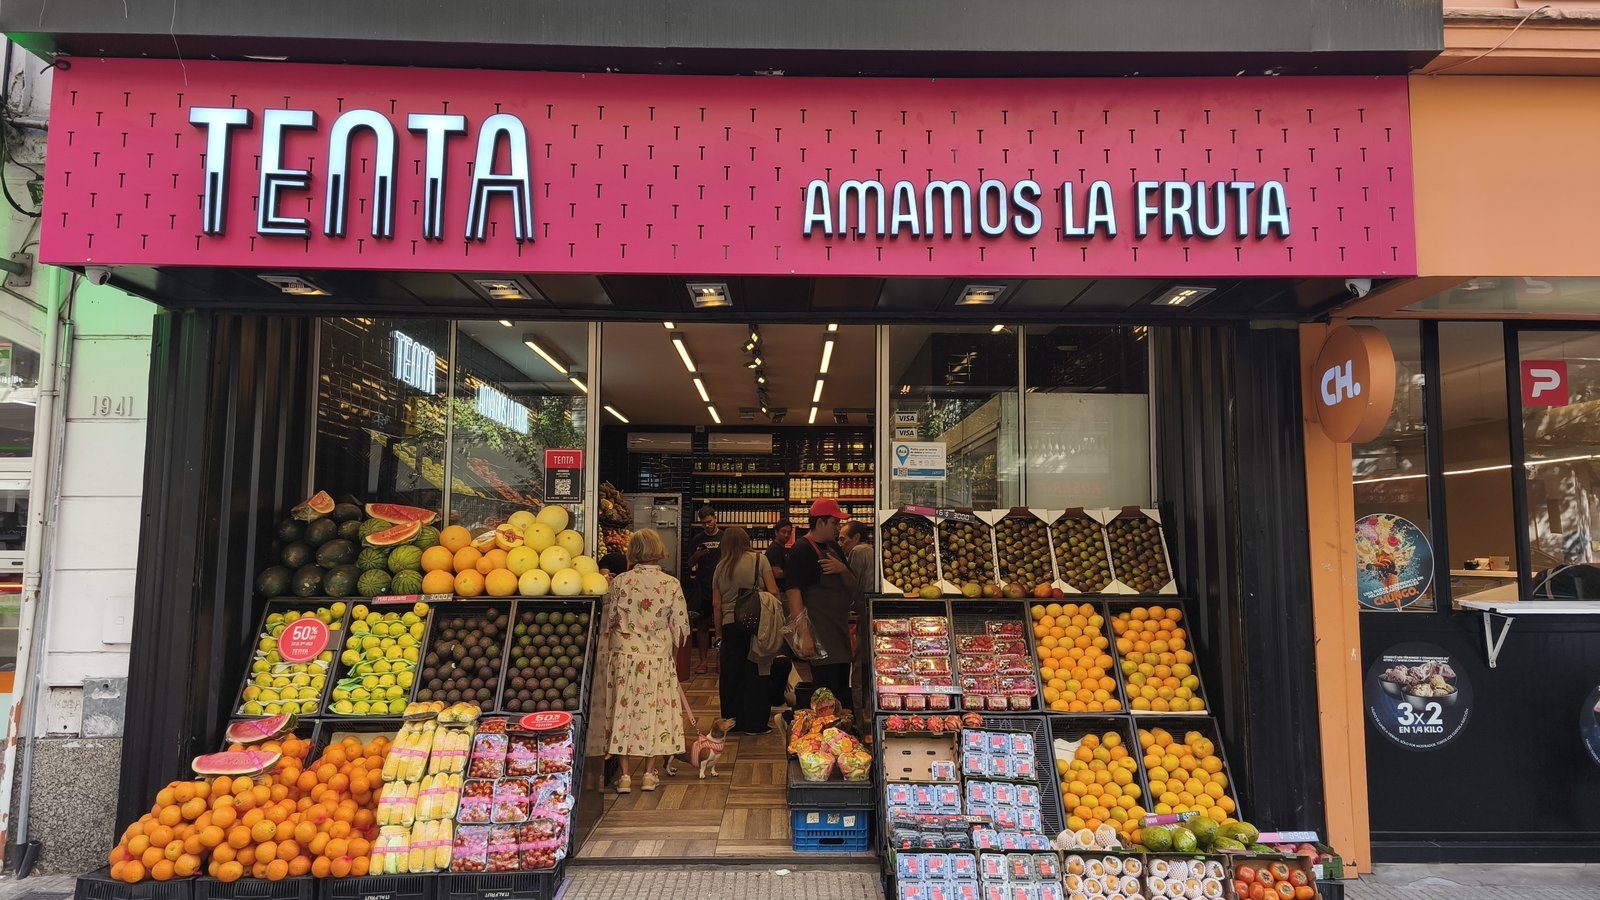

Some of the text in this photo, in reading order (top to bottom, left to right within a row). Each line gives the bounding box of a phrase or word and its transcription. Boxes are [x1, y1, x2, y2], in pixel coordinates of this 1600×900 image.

[188, 105, 535, 243] TENTA
[802, 178, 1292, 240] AMAMOS LA FRUTA
[1320, 359, 1361, 407] CH.
[92, 395, 134, 417] 1941
[553, 455, 574, 465] TENTA
[1398, 726, 1410, 734] EN
[1412, 726, 1423, 734] 1/4
